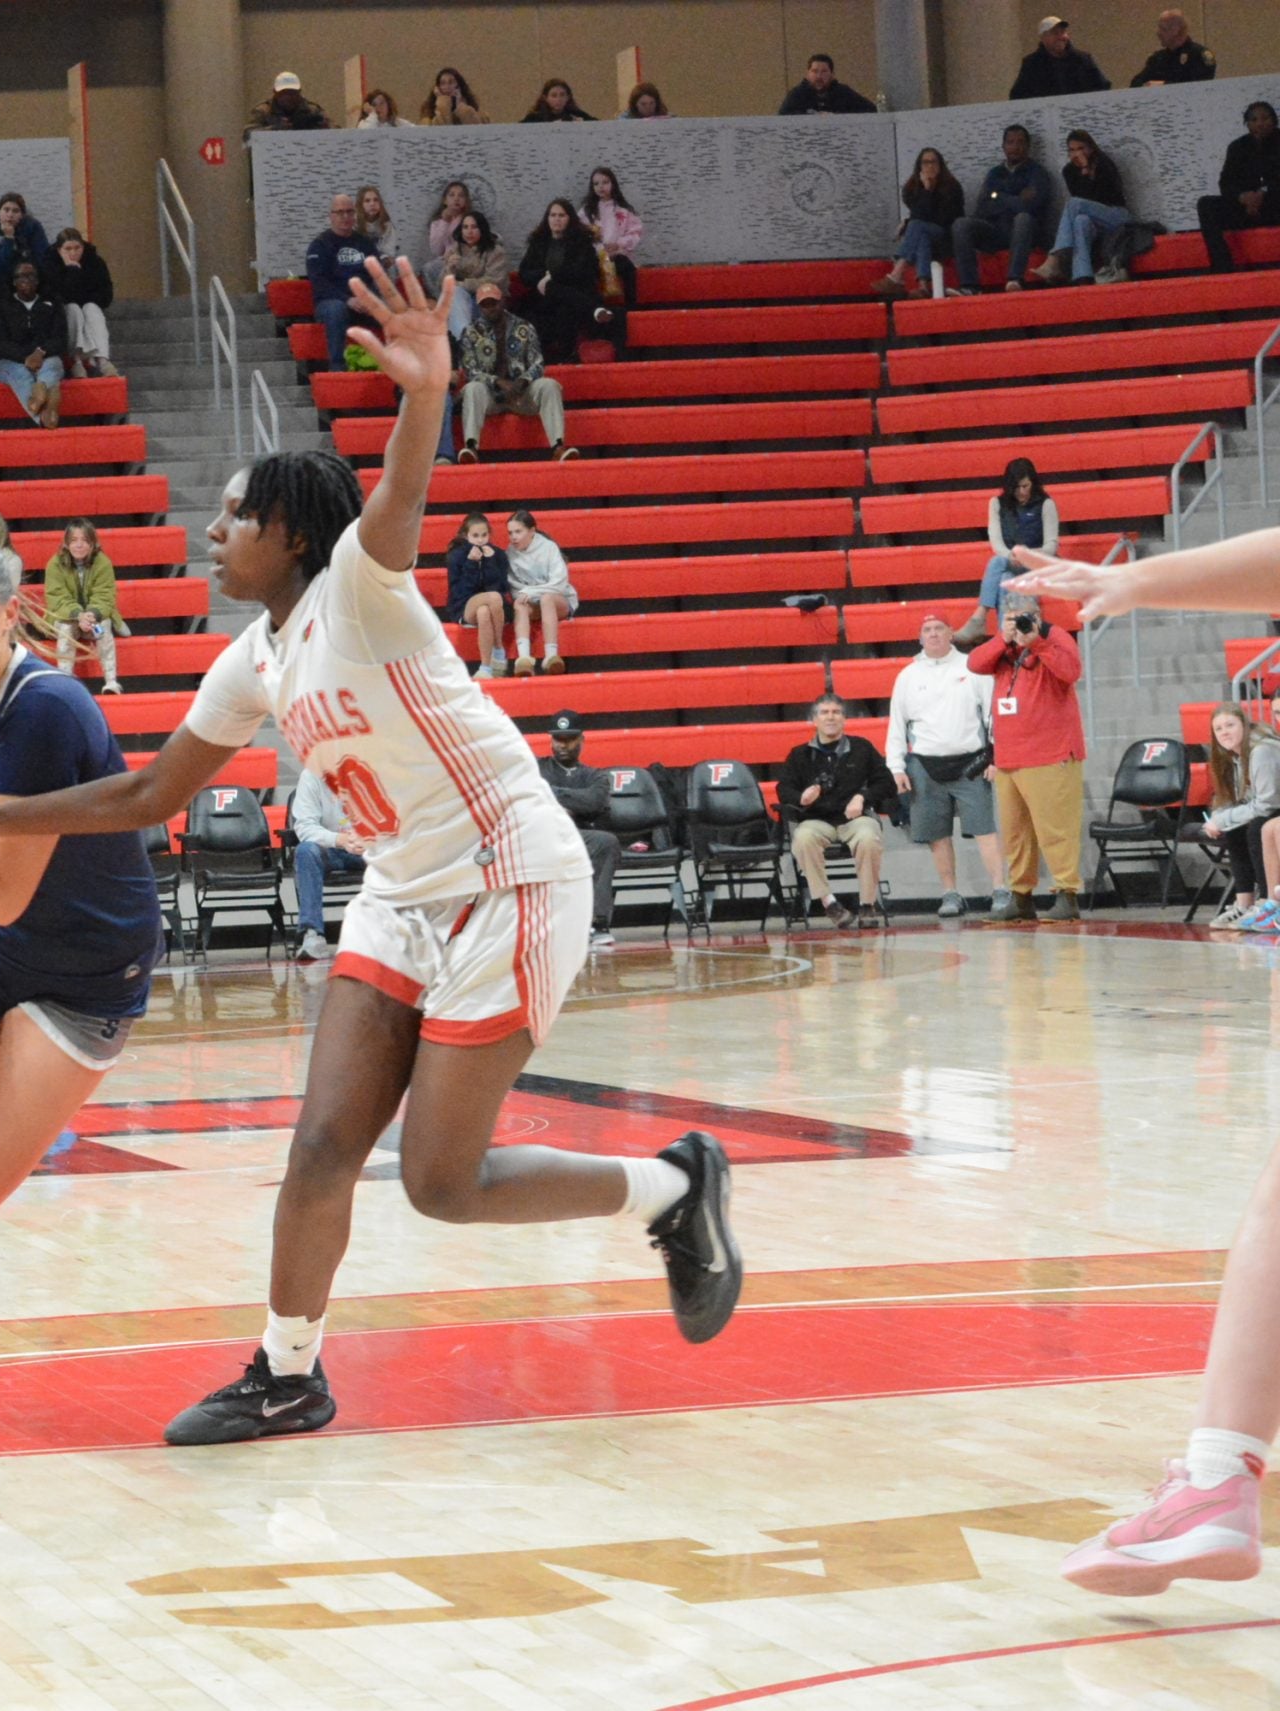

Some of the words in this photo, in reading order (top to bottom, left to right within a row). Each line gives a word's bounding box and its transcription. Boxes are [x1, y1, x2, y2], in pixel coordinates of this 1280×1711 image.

[1142, 742, 1168, 764] F
[610, 770, 636, 791] F
[708, 763, 733, 785] F
[211, 789, 238, 811] F
